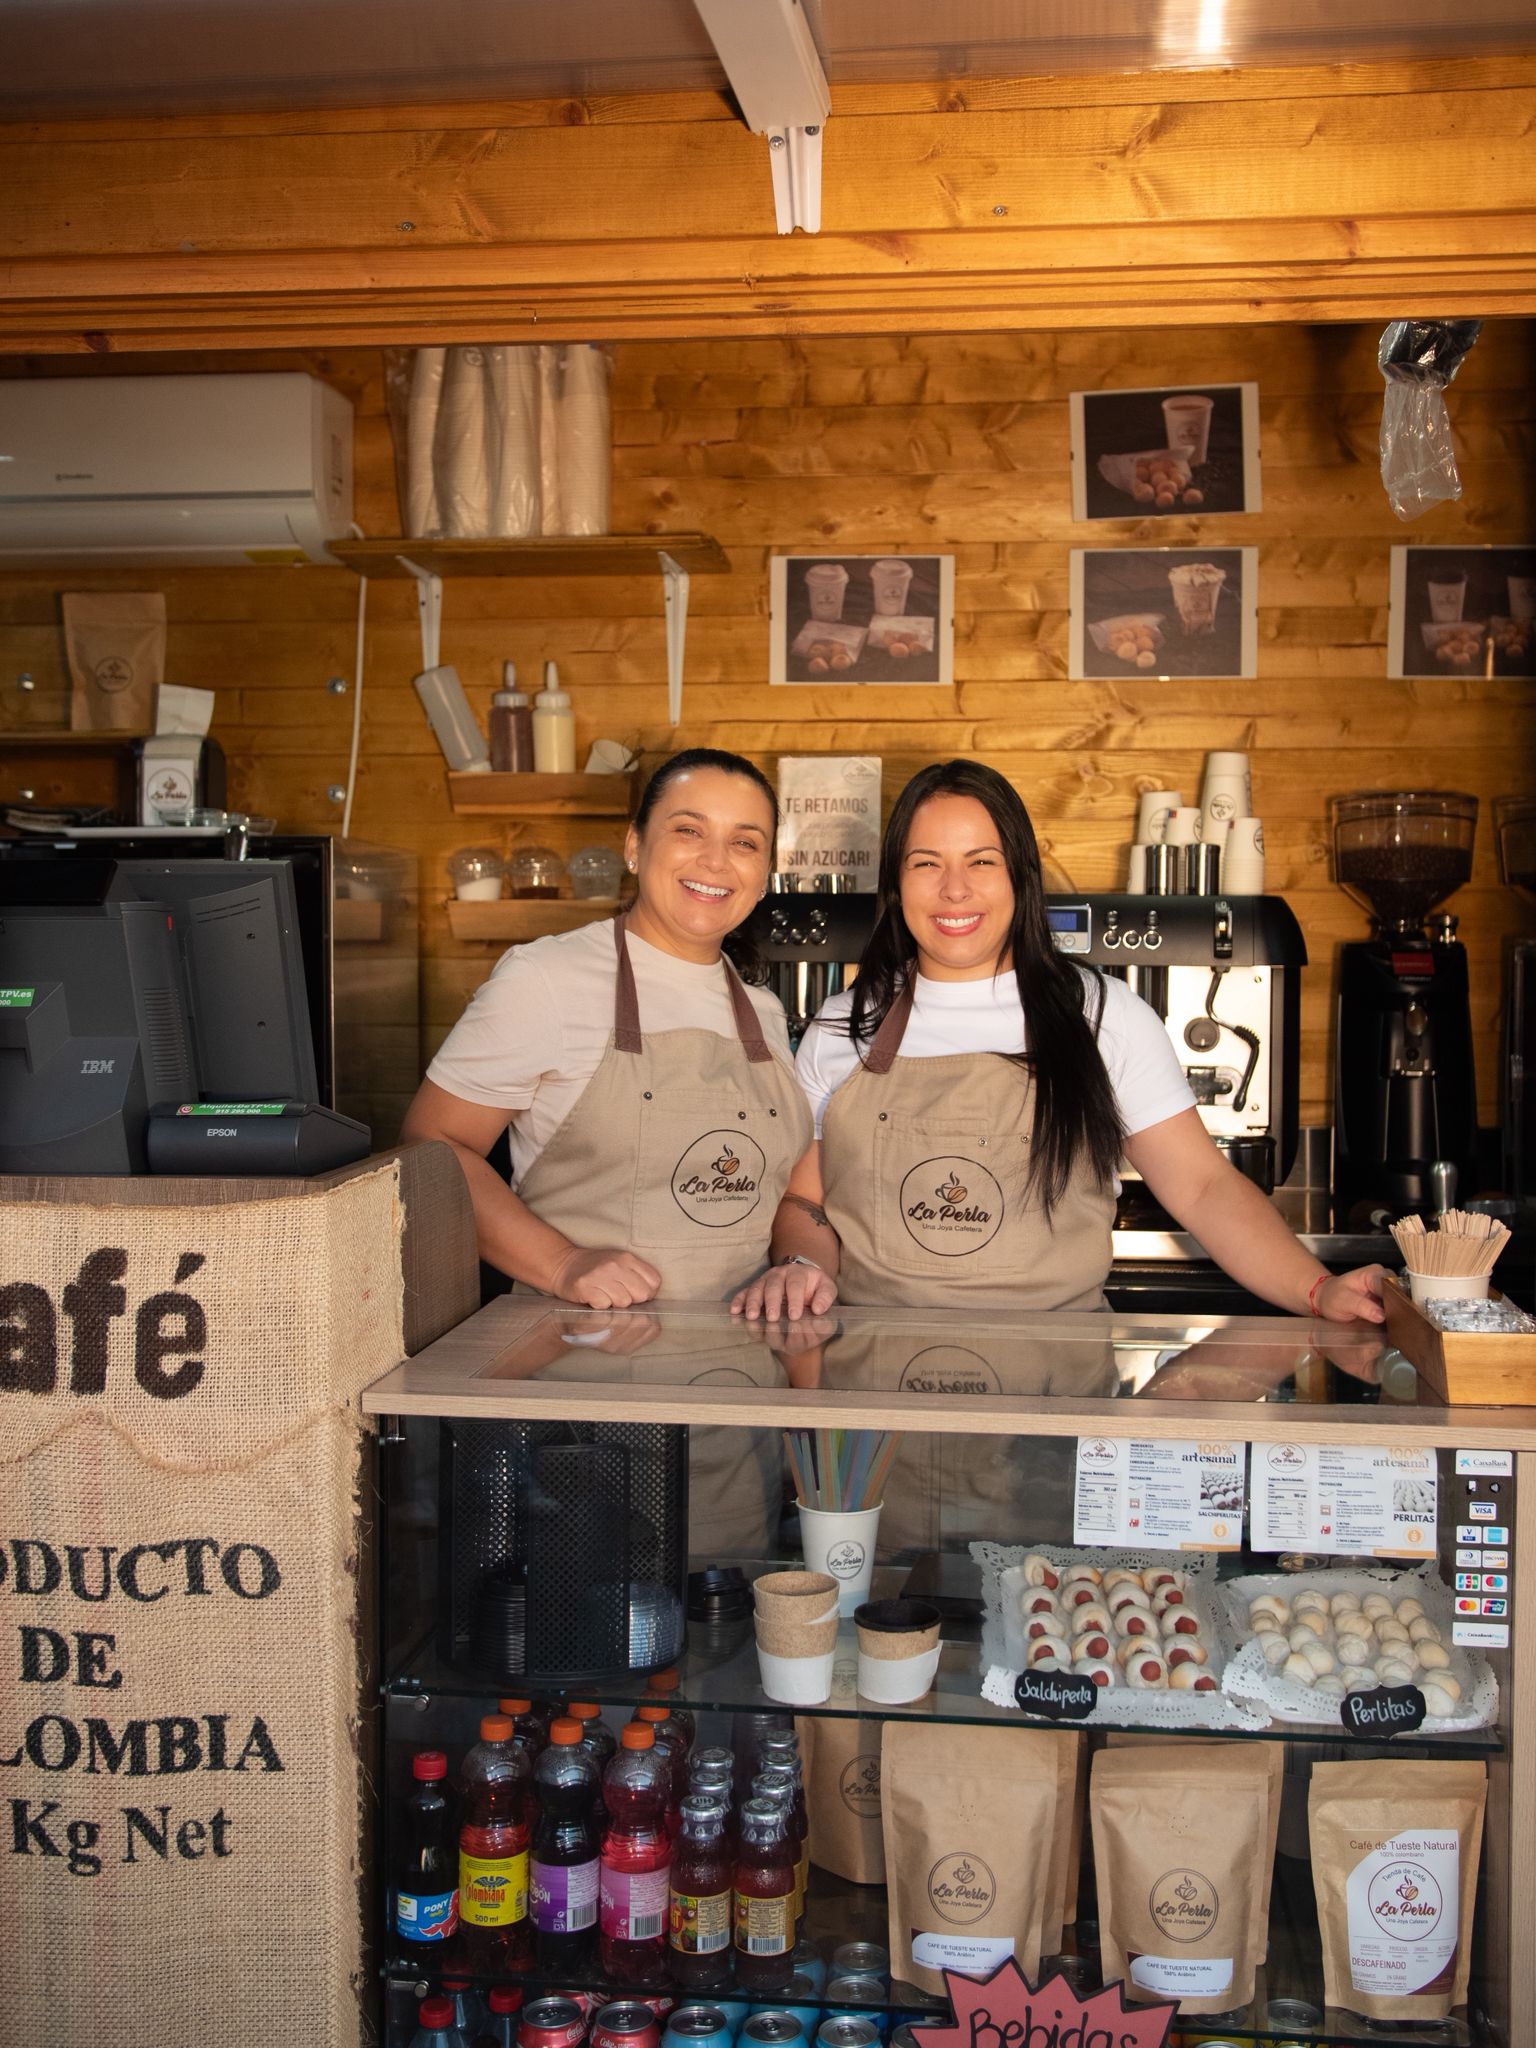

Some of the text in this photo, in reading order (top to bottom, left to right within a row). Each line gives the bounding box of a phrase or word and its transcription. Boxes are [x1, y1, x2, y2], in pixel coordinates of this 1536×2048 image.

[785, 797, 868, 814] TE RETAMOS
[787, 850, 808, 867] SIN
[80, 1060, 115, 1074] IBM
[207, 1128, 237, 1137] EPSON
[679, 1175, 756, 1195] La Perla
[708, 1196, 722, 1204] Joya
[907, 1201, 992, 1223] La Perla
[937, 1224, 953, 1232] Joya
[954, 1225, 983, 1233] Cafetera
[1181, 1452, 1237, 1464] artesanal
[1372, 1457, 1430, 1469] artesanal
[1473, 1458, 1507, 1467] CaixaBank
[1393, 1513, 1435, 1523] PERLITAS
[0, 1537, 282, 1602] DUCTO
[18, 1624, 123, 1689] DE
[1018, 1676, 1092, 1710] Salchiperla
[1350, 1696, 1416, 1726] Perlitas
[9, 1798, 233, 1877] Kg Net
[1350, 1840, 1457, 1850] Café de Tueste Natural
[1382, 1869, 1402, 1882] Tienda
[1412, 1870, 1426, 1882] Café
[465, 1883, 505, 1903] Colombiana
[932, 1883, 990, 1901] La Perla
[424, 1898, 449, 1914] PONY
[1155, 1900, 1213, 1918] La Perla
[1375, 1900, 1437, 1917] La Perla
[474, 1914, 498, 1923] 500 ml
[1352, 1957, 1407, 1970] DESCAFEINADO
[969, 2005, 1138, 2048] Bebidas
